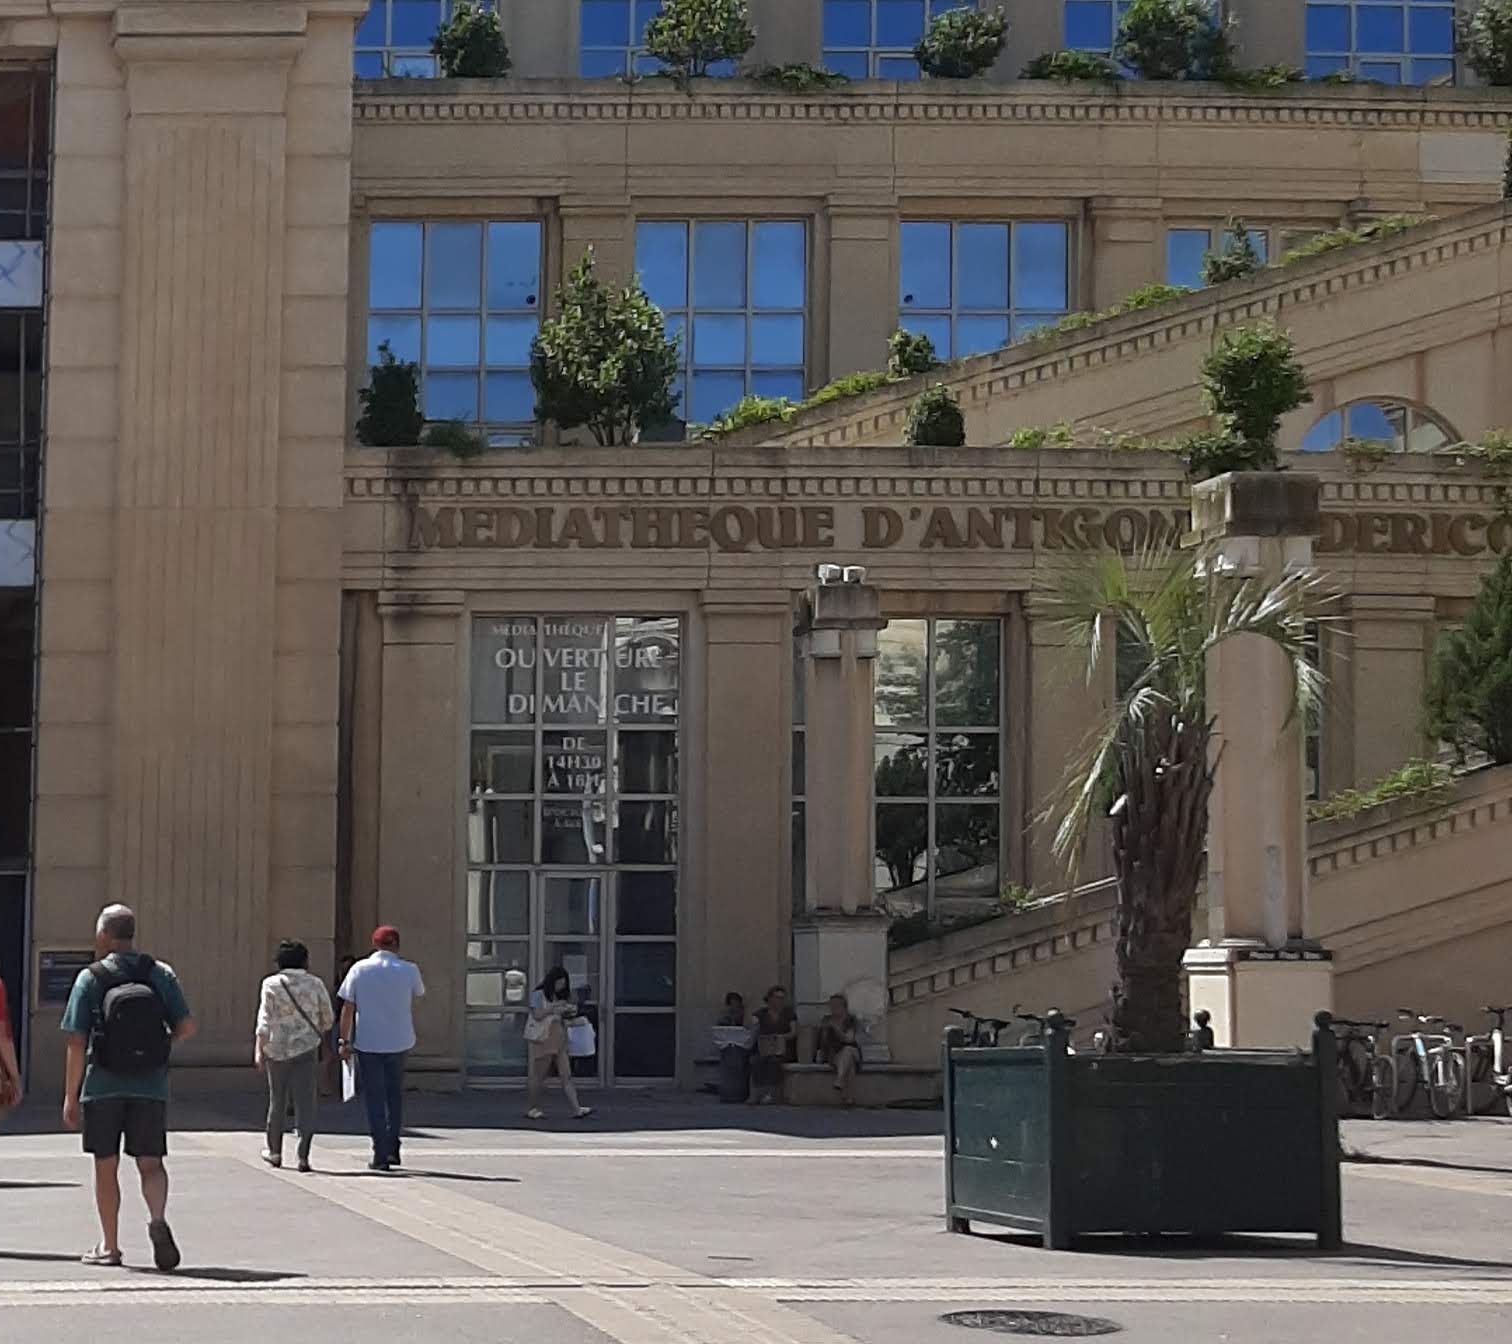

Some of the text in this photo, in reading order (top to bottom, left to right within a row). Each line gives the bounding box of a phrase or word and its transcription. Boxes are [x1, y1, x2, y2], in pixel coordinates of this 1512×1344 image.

[409, 505, 835, 554] MEDIATHEQUE
[860, 506, 1192, 556] D'ANTIGON
[494, 647, 664, 669] OUVERTURE
[561, 671, 586, 692] LE
[508, 693, 669, 715] DIMANCHE
[562, 736, 585, 750] DE
[548, 755, 602, 769] 14H30
